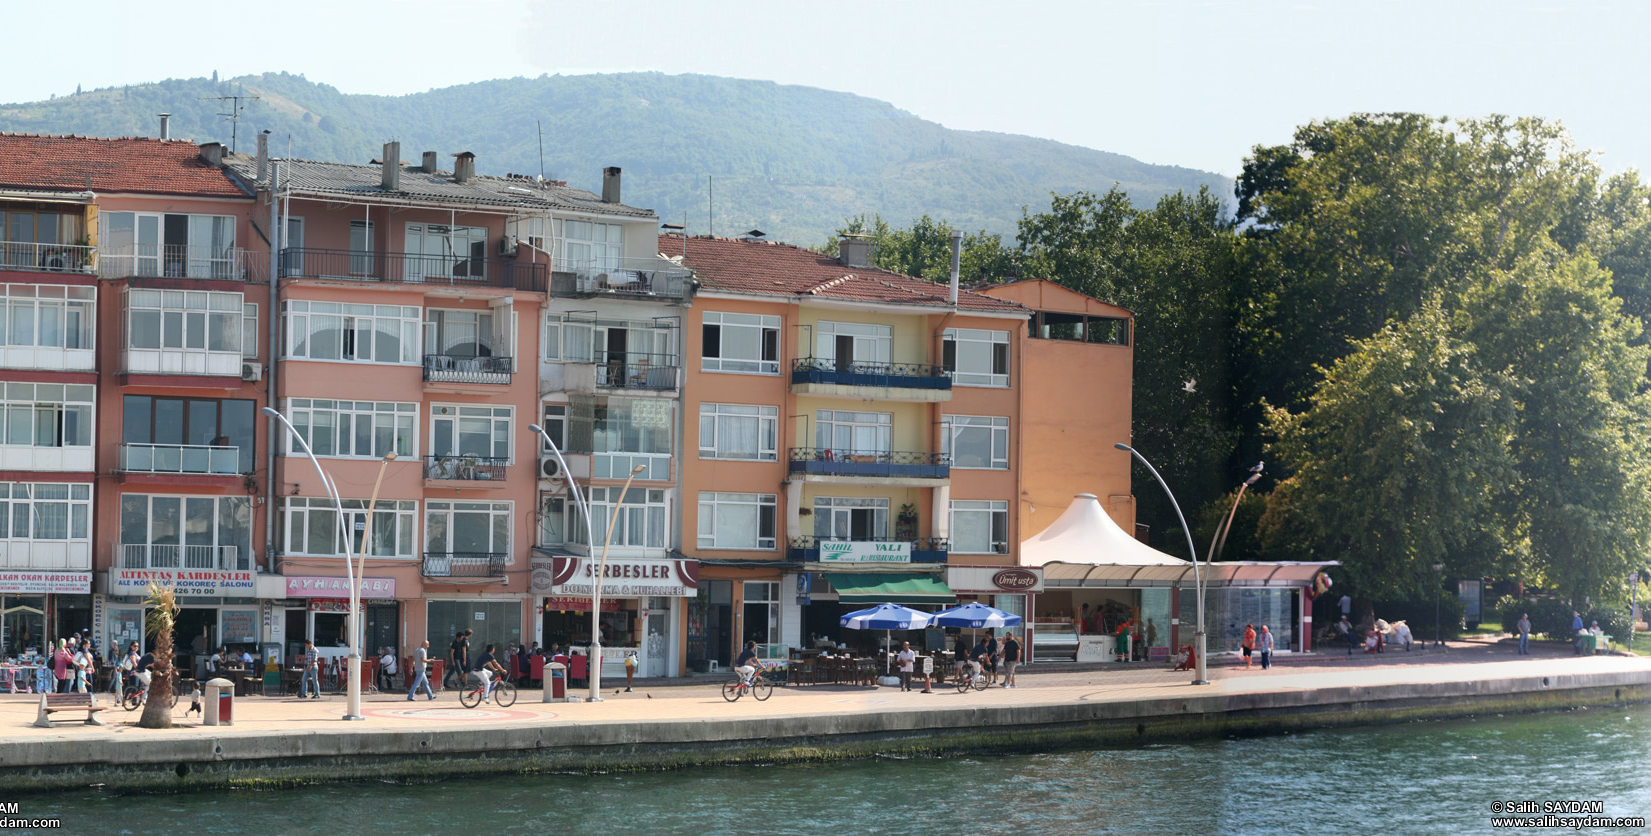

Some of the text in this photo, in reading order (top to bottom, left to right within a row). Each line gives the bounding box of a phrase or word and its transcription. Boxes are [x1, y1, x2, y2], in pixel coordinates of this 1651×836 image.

[177, 571, 250, 582] KARDEŞLER
[586, 564, 670, 579] SERBESLER
[45, 574, 88, 583] KARDEŞLER
[999, 574, 1034, 586] Ümit usta
